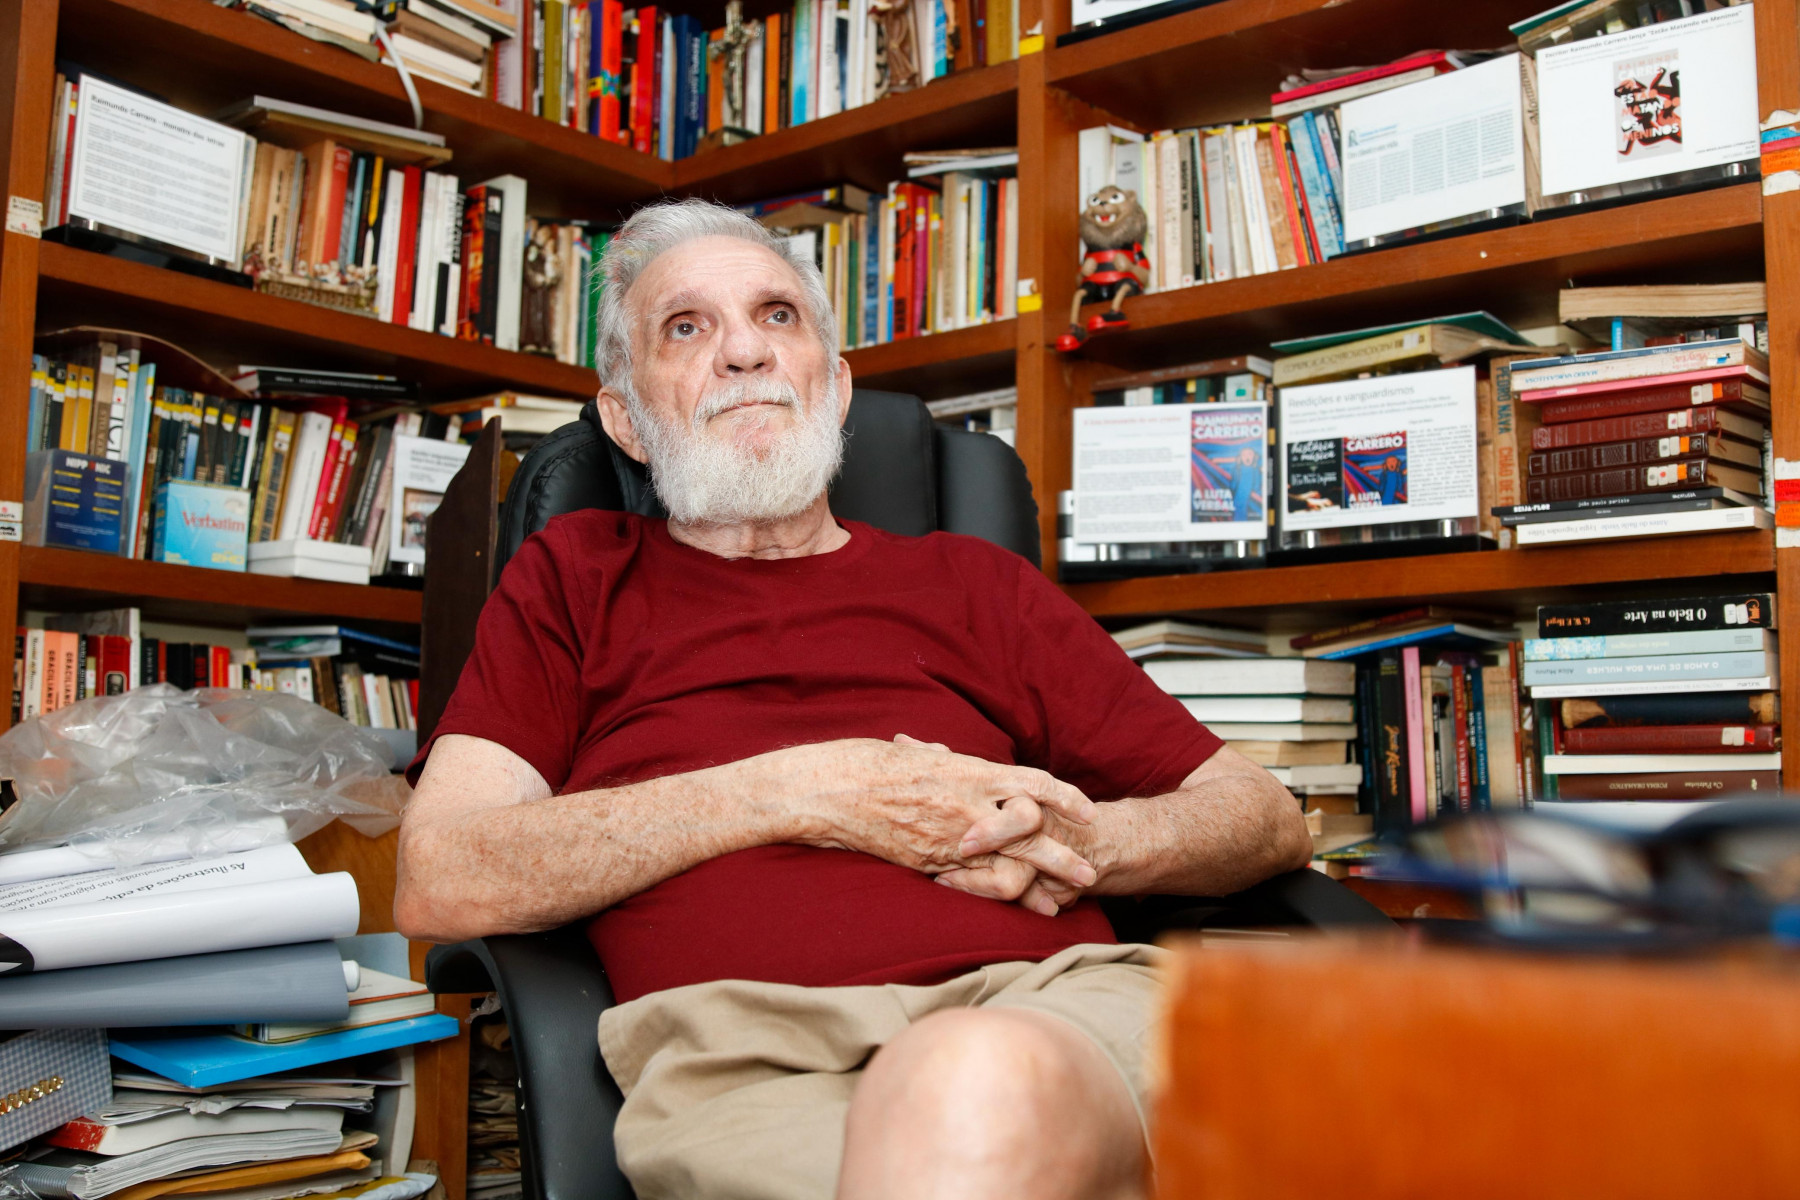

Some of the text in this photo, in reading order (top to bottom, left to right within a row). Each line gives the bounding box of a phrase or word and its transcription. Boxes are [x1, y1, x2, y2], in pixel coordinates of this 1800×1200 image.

[1623, 123, 1680, 142] MENINOS
[1344, 387, 1415, 403] vanguardismos
[1496, 366, 1511, 436] PEDRO NAVA
[1193, 425, 1262, 440] CARRERO
[1345, 436, 1404, 452] CARRERO
[1204, 488, 1233, 500] LUTA
[1358, 491, 1381, 501] LUTA
[1193, 499, 1236, 512] VERBAL
[1513, 502, 1550, 513] BEIJA-FLOR
[182, 510, 246, 532] Verbatim
[1545, 617, 1564, 628] Hegel
[1624, 608, 1707, 623] O Belo na Arte
[1587, 661, 1719, 675] O AMOR DE UMA BOA MULHER
[46, 650, 55, 705] GRACILIANO
[229, 862, 246, 871] As
[157, 866, 226, 886] ilustrações
[58, 883, 96, 900] páginas
[98, 880, 114, 889] nas
[137, 883, 155, 892] da
[37, 896, 58, 906] com
